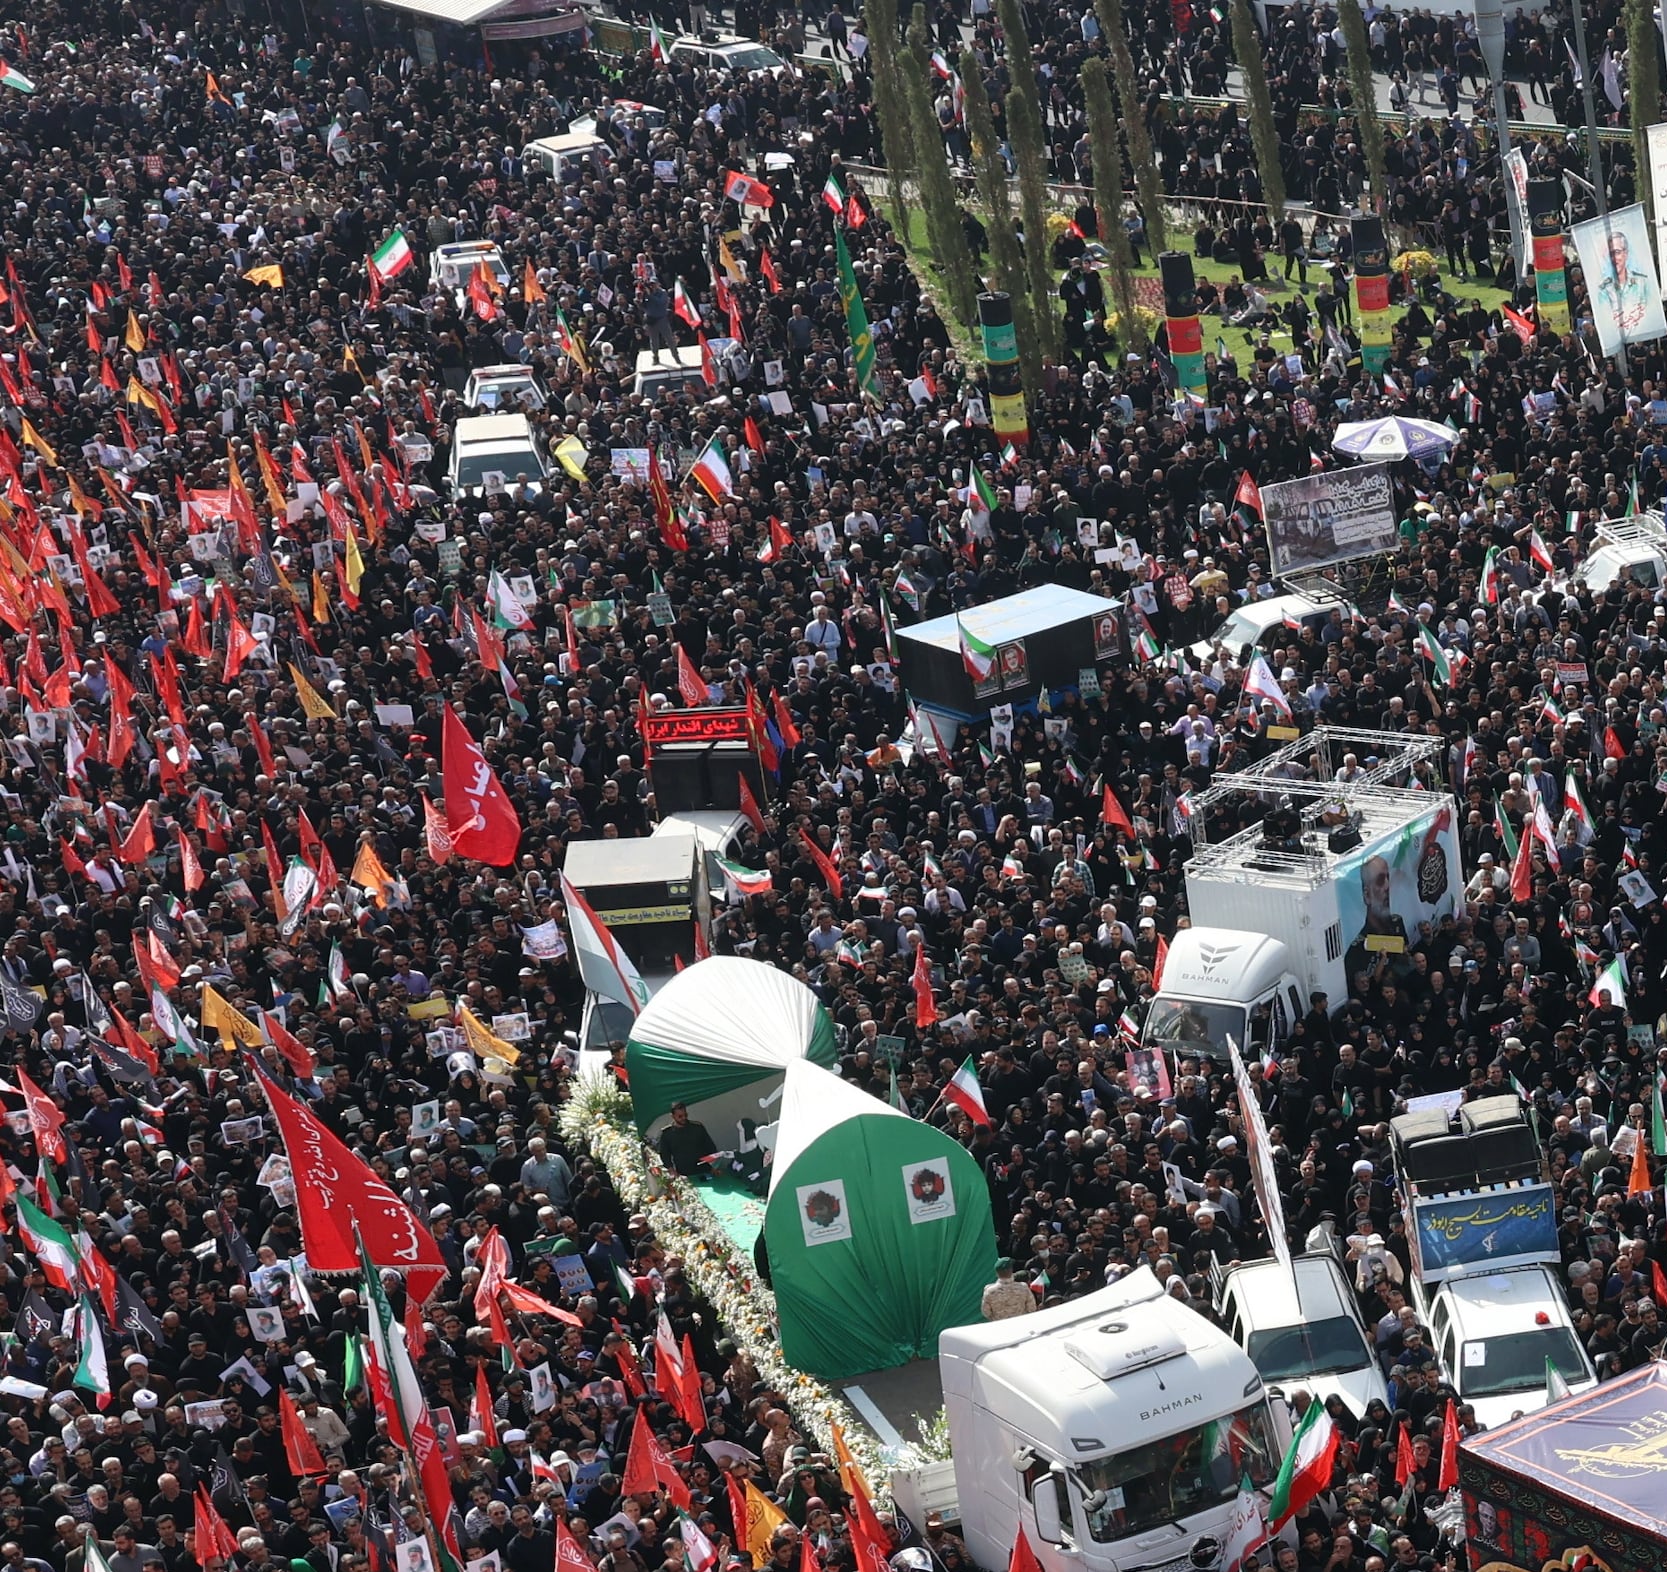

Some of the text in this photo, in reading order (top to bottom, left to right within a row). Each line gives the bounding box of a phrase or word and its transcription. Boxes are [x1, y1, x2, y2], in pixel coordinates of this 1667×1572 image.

[672, 718, 739, 737] شهدای اقتدار
[1182, 973, 1230, 984] BAHMAN
[1426, 1198, 1548, 1240] ناحیه مقاومت بسیج ابوذر
[1139, 1393, 1204, 1422] BAHMAN
